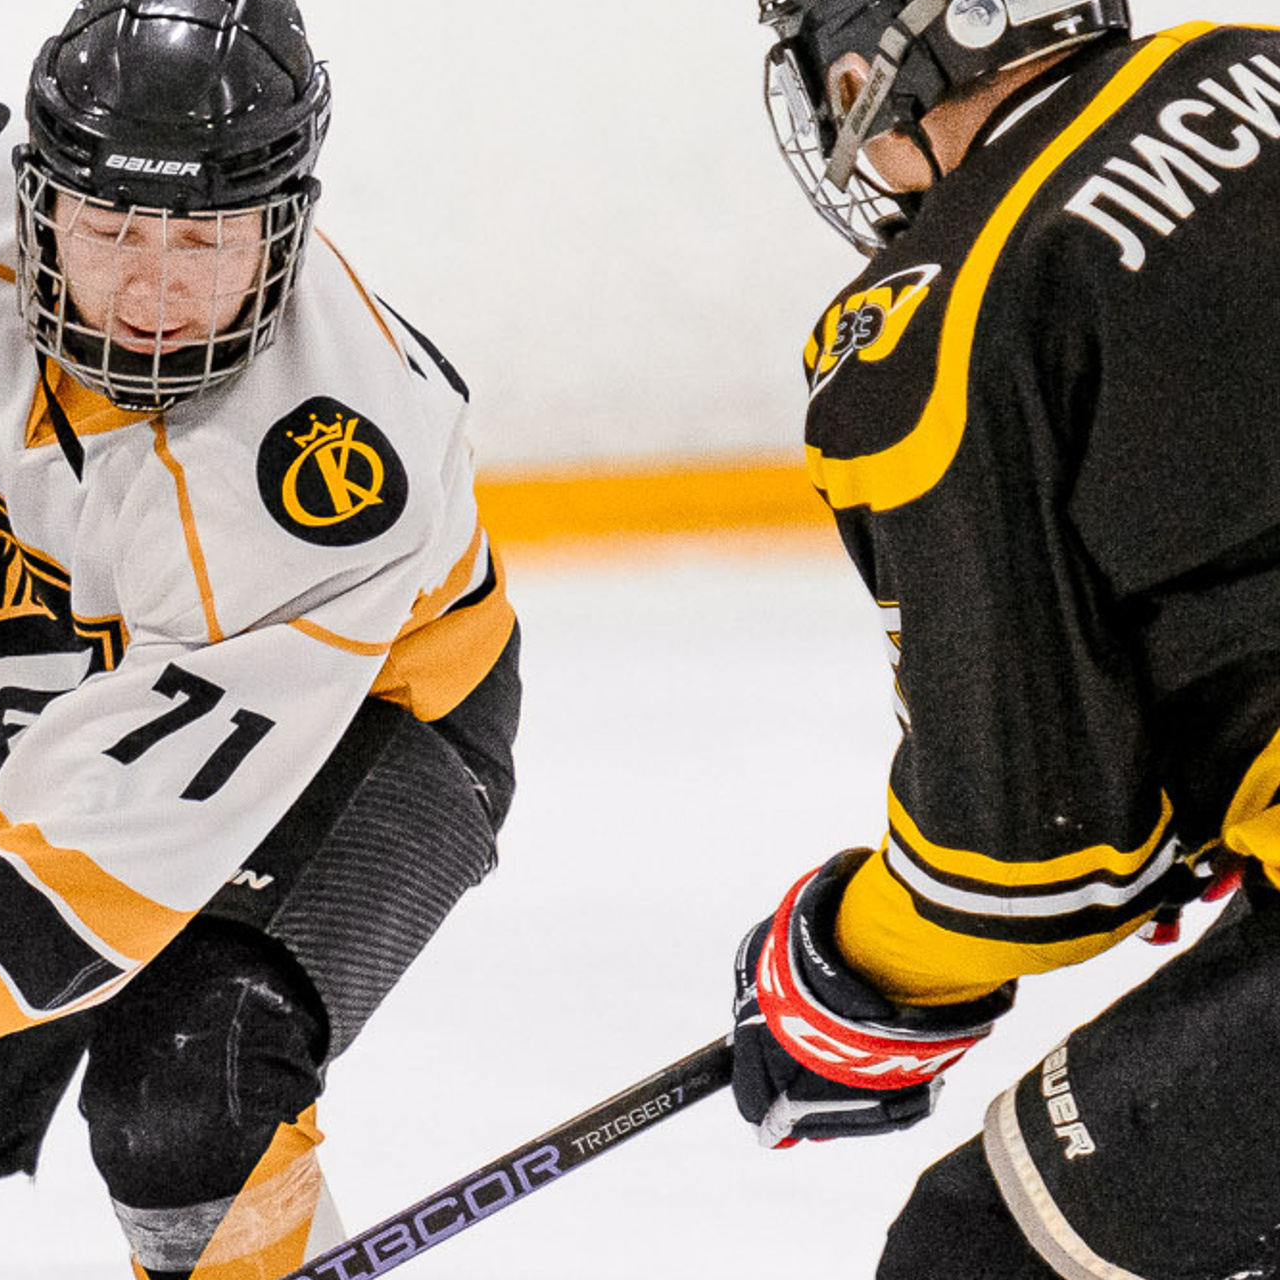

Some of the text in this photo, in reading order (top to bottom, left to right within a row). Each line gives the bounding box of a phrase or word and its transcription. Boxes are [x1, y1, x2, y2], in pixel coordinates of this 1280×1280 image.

[105, 154, 202, 177] BAUER
[101, 662, 277, 802] 71
[1041, 1044, 1096, 1160] AUER
